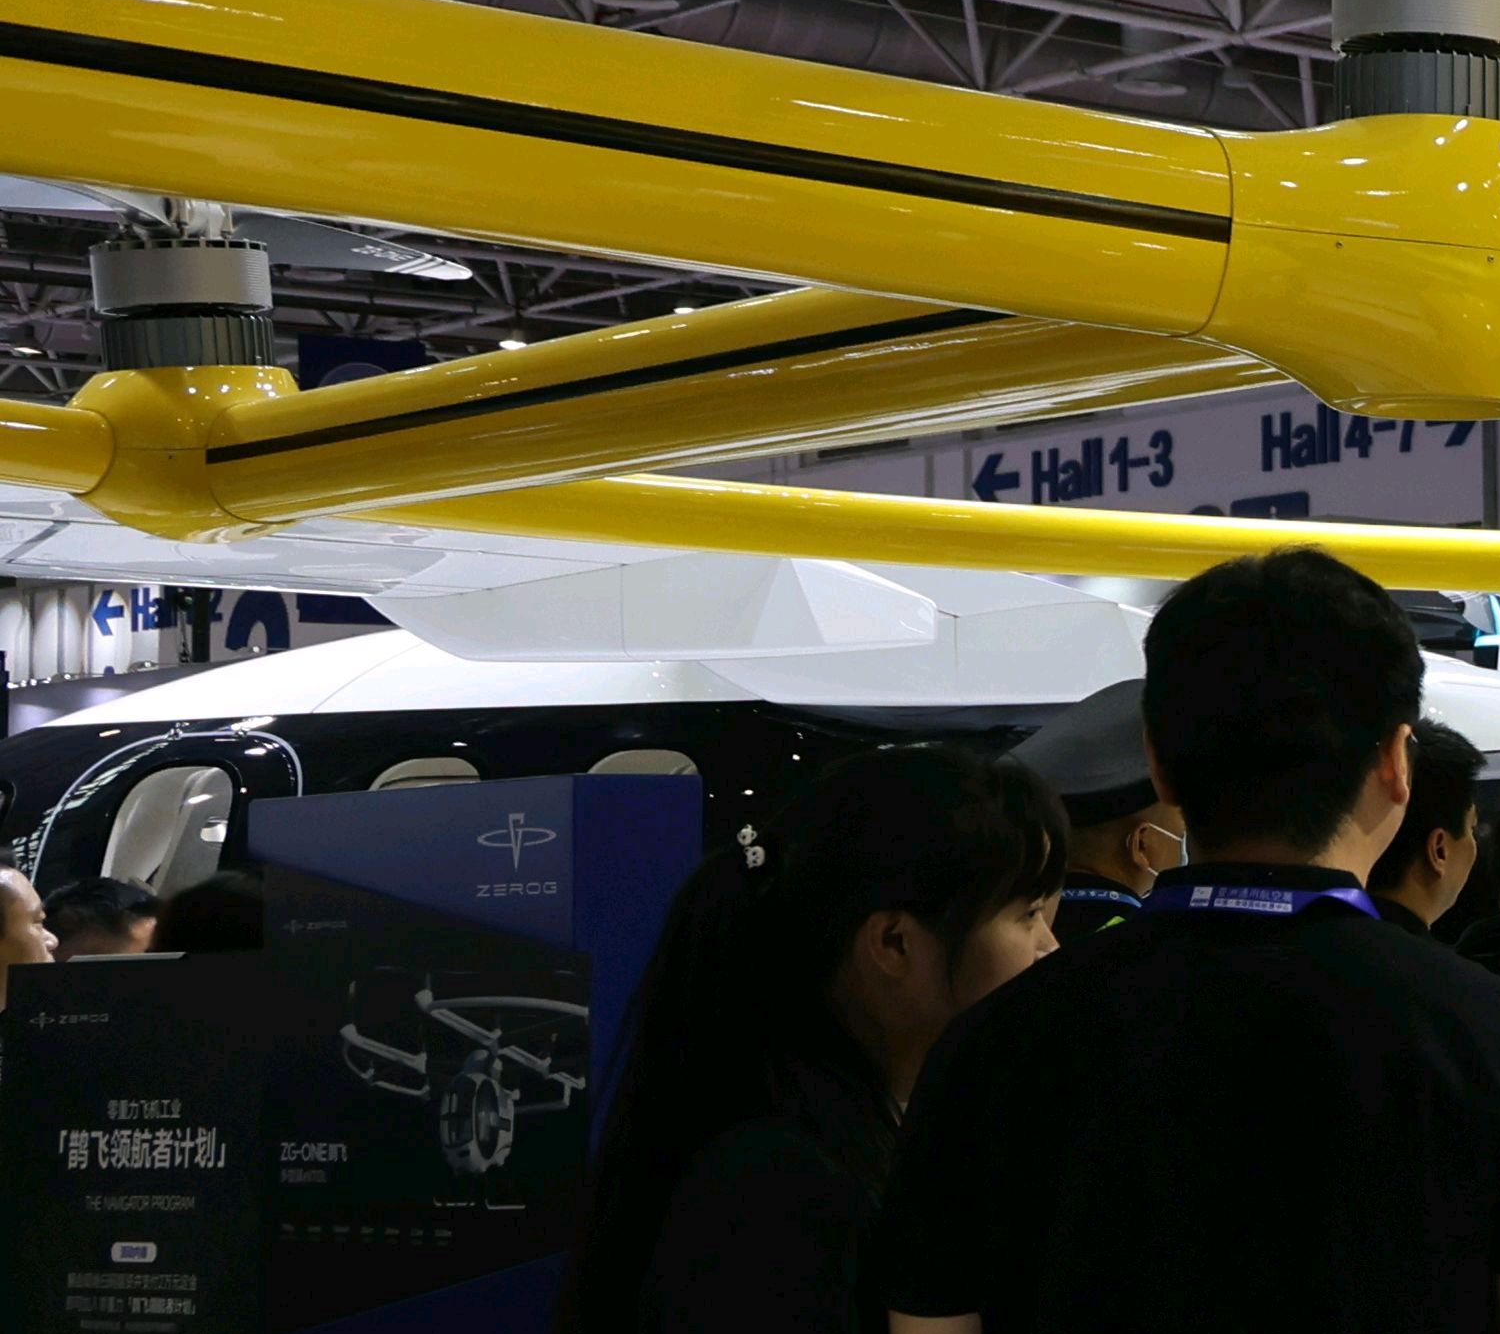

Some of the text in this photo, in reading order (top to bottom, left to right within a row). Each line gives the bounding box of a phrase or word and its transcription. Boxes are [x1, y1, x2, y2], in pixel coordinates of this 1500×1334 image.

[1031, 429, 1173, 505] Hall 1-3
[1262, 403, 1340, 472] Hall
[475, 881, 557, 897] ZEROG
